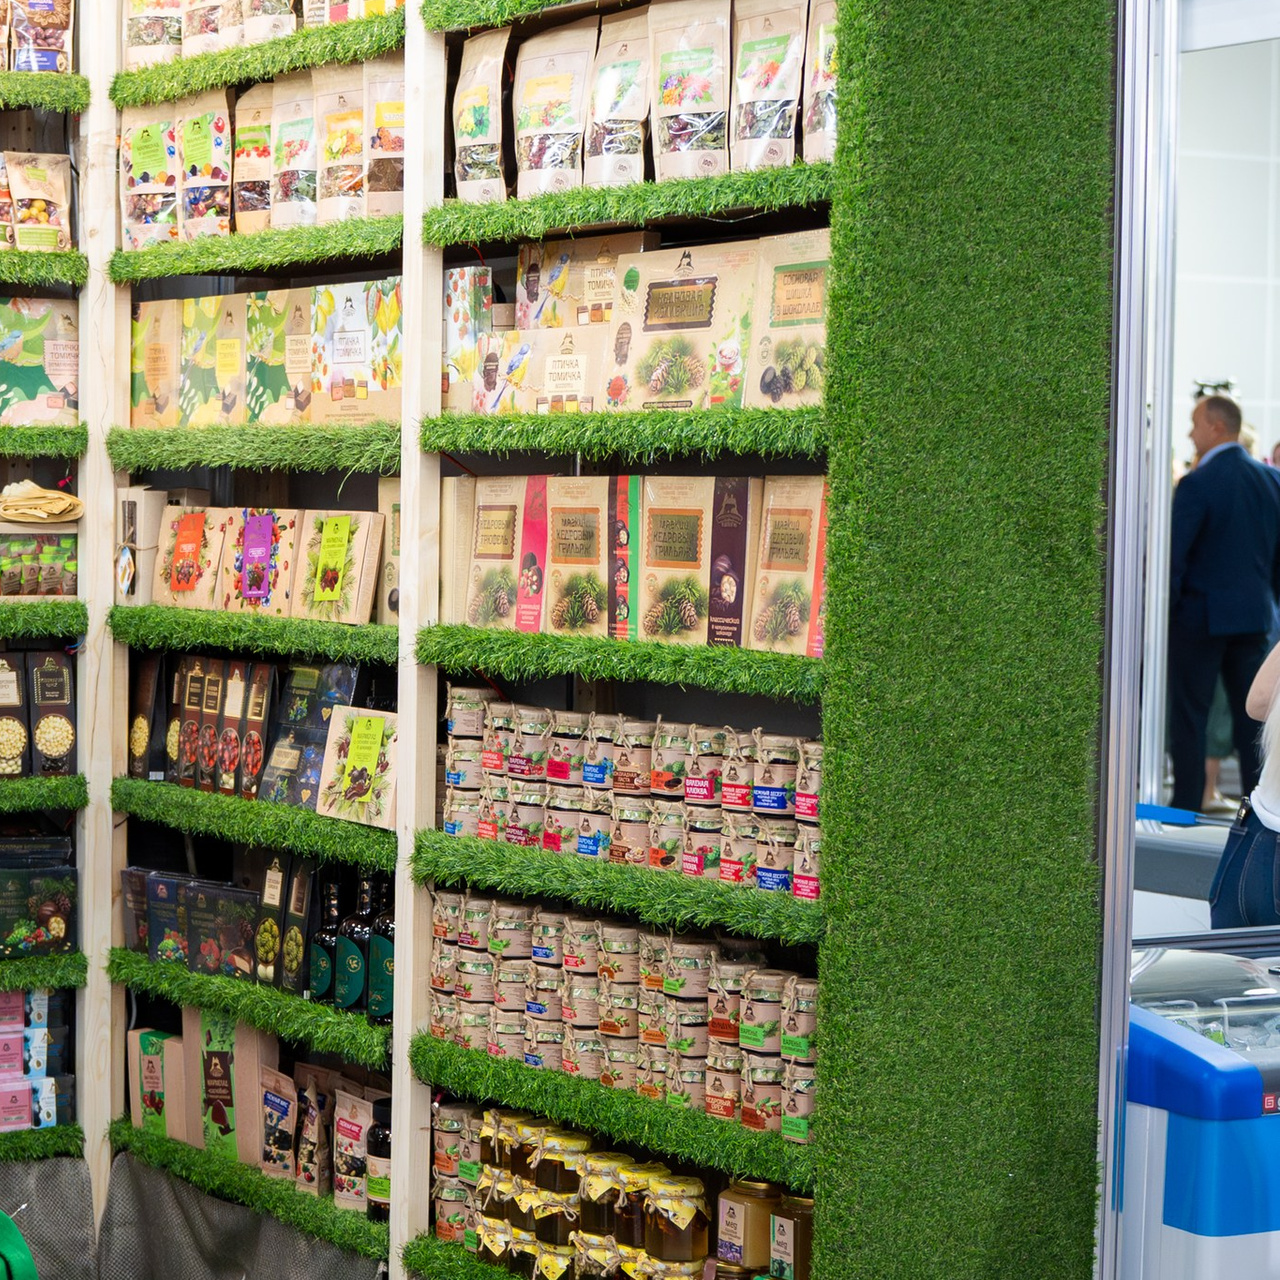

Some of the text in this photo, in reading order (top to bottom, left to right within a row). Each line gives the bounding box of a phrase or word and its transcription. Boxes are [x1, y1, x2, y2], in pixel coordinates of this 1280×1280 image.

[782, 270, 819, 286] СОСНОВАЯ
[587, 279, 615, 291] ТОМИЧК
[785, 287, 813, 300] ШИШКА
[782, 301, 822, 316] ШОКОЛАДЕ
[52, 343, 79, 351] ПТИЧК
[50, 351, 79, 360] ТОМИЧК
[552, 358, 579, 370] ПТИЧКА
[548, 371, 582, 382] ТОМИЧКА
[556, 528, 595, 541] КЕДРОВЫЙ
[654, 545, 693, 559] ГРИЛЬЯЖ
